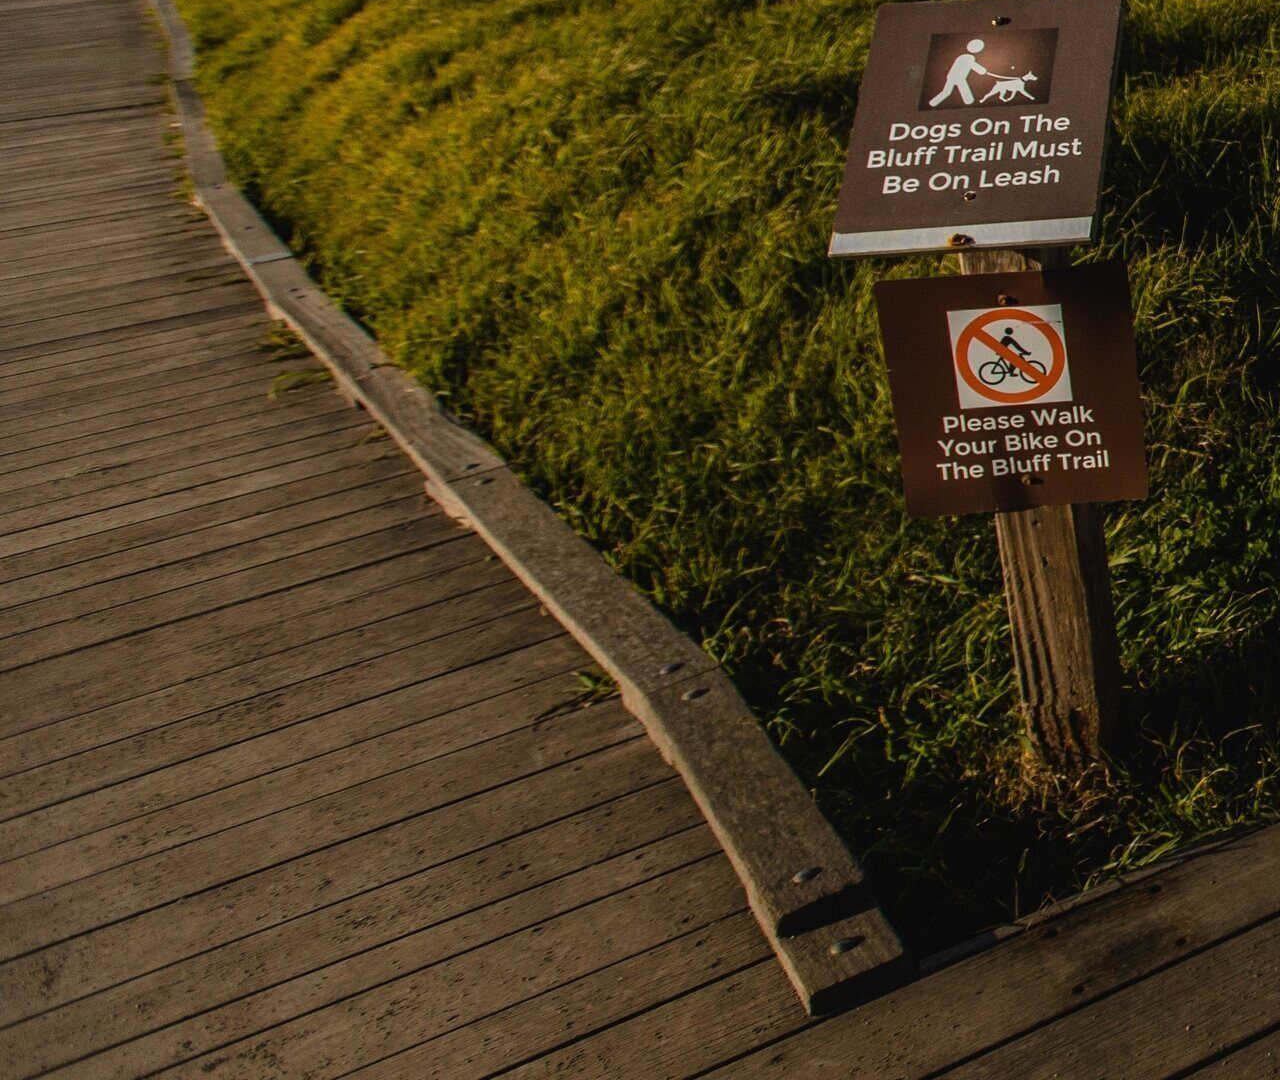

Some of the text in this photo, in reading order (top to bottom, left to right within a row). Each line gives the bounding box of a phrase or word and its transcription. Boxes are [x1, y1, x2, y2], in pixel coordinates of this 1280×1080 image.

[889, 113, 1070, 143] Dogs On The
[867, 138, 1082, 168] Bluff Trail Must
[882, 164, 1060, 194] Be On Leash
[942, 405, 1094, 433] Please Walk
[937, 429, 1101, 456] Your Bike On
[936, 449, 1109, 480] The Bluff Trail
